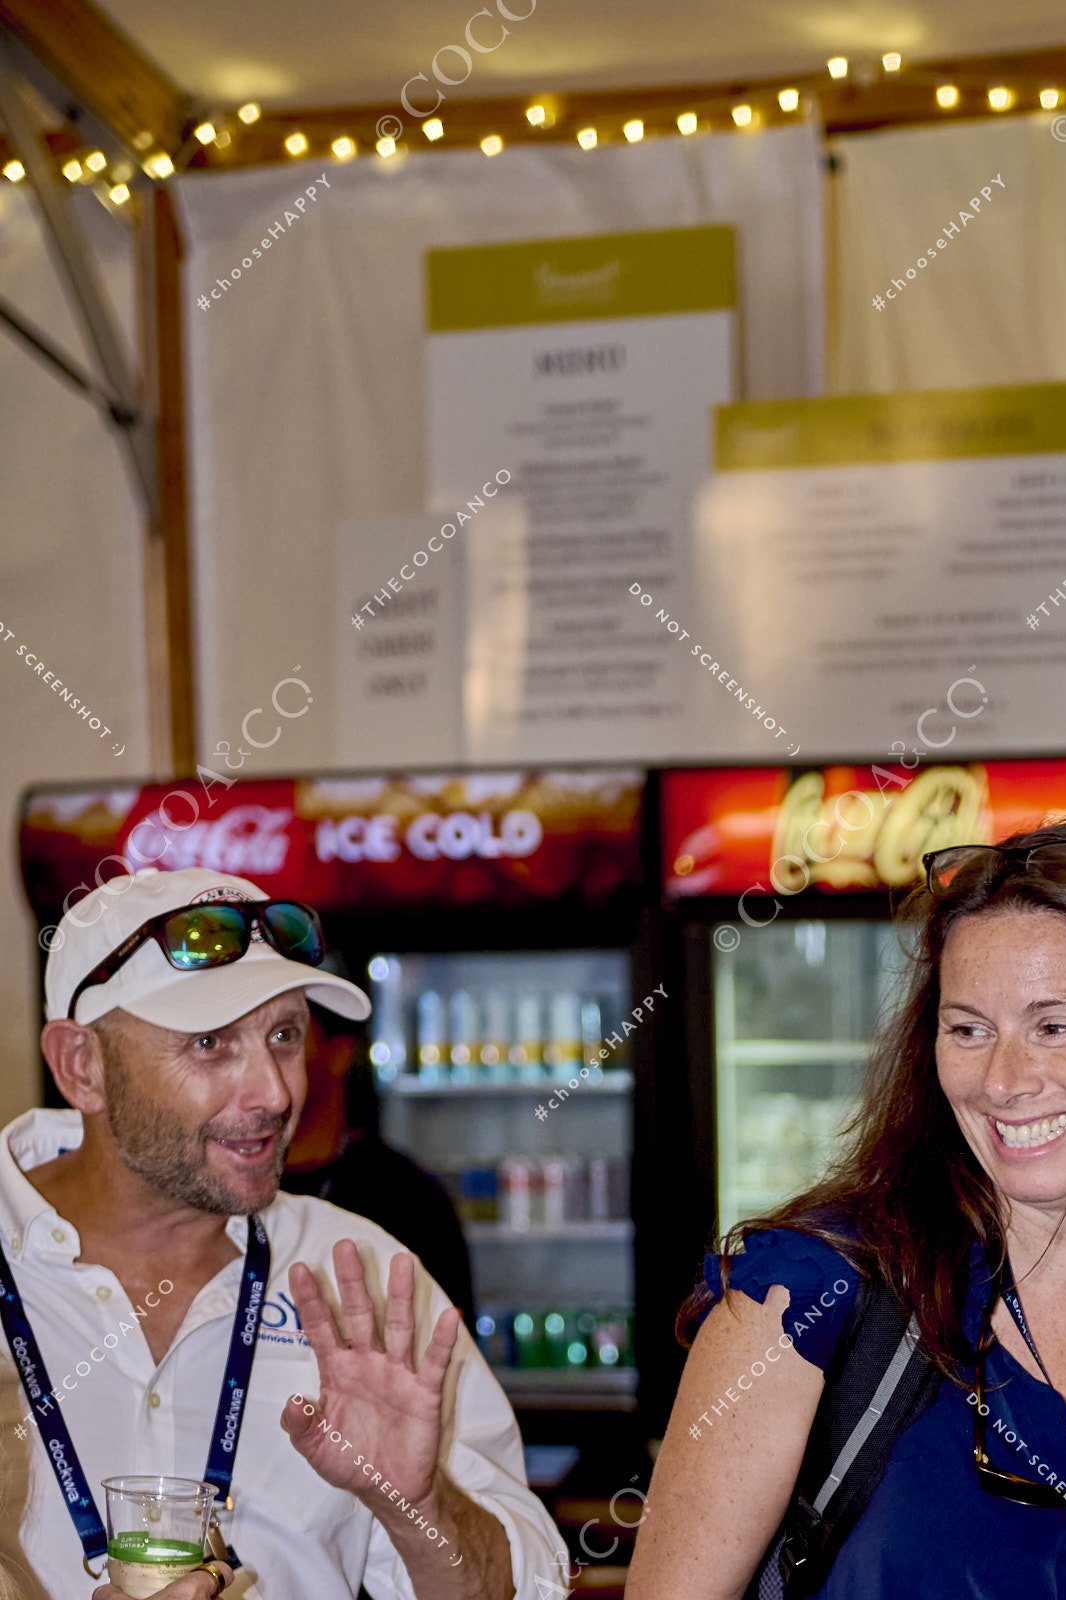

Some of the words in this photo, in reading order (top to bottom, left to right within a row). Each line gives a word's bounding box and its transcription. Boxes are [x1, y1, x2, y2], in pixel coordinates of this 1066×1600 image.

[315, 815, 401, 864] ICE
[406, 810, 544, 861] COLD
[240, 1280, 264, 1346] dockwa
[12, 1335, 43, 1400] dockwa
[221, 1387, 245, 1453] dockwa
[49, 1438, 81, 1504] dockwa
